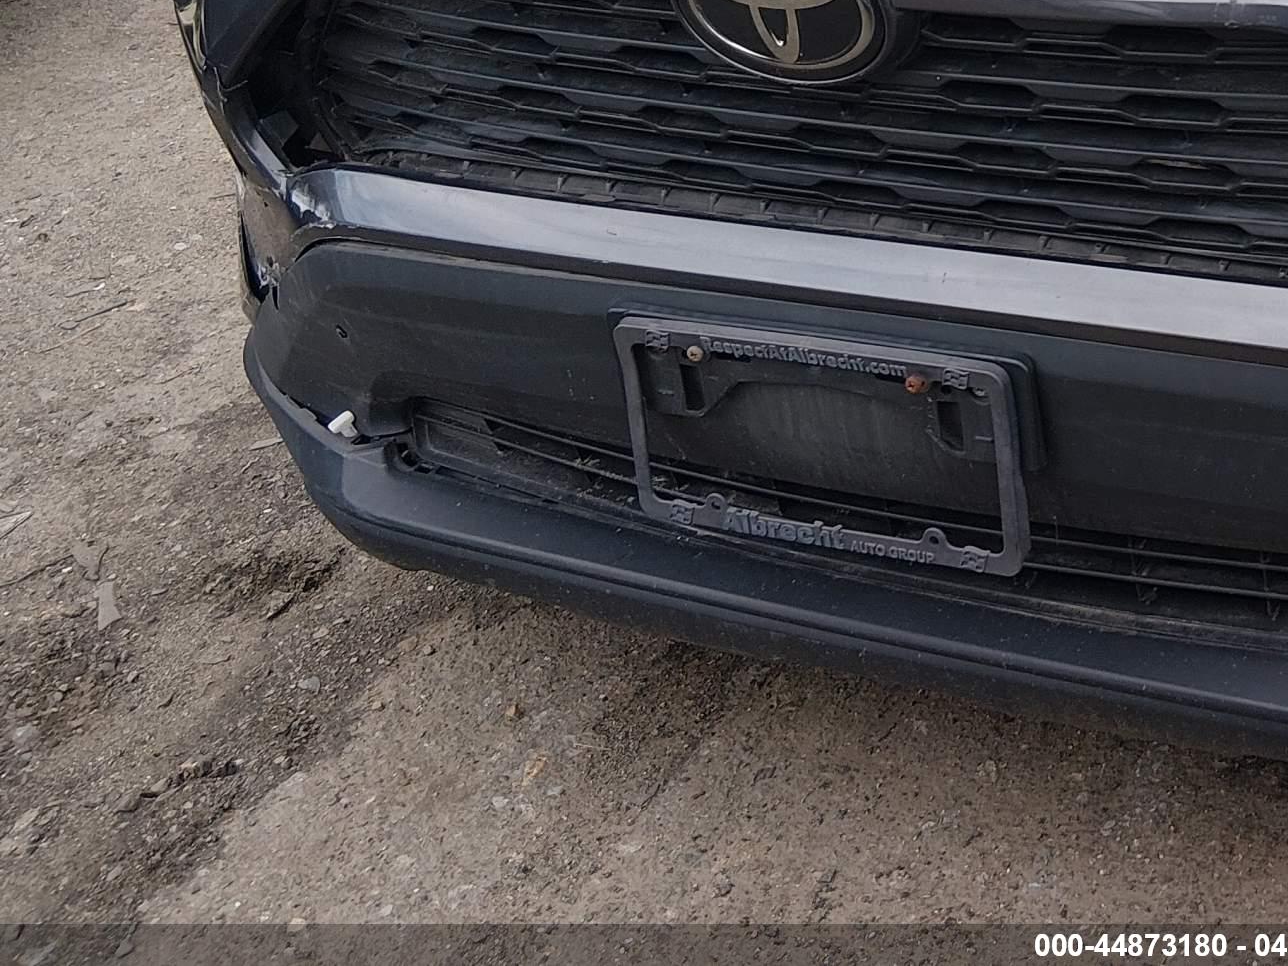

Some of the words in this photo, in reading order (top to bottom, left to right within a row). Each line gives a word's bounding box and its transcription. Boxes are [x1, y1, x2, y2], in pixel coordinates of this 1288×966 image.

[722, 506, 845, 550] Albrecht
[850, 540, 886, 557] AUTO
[887, 546, 936, 564] GROUP
